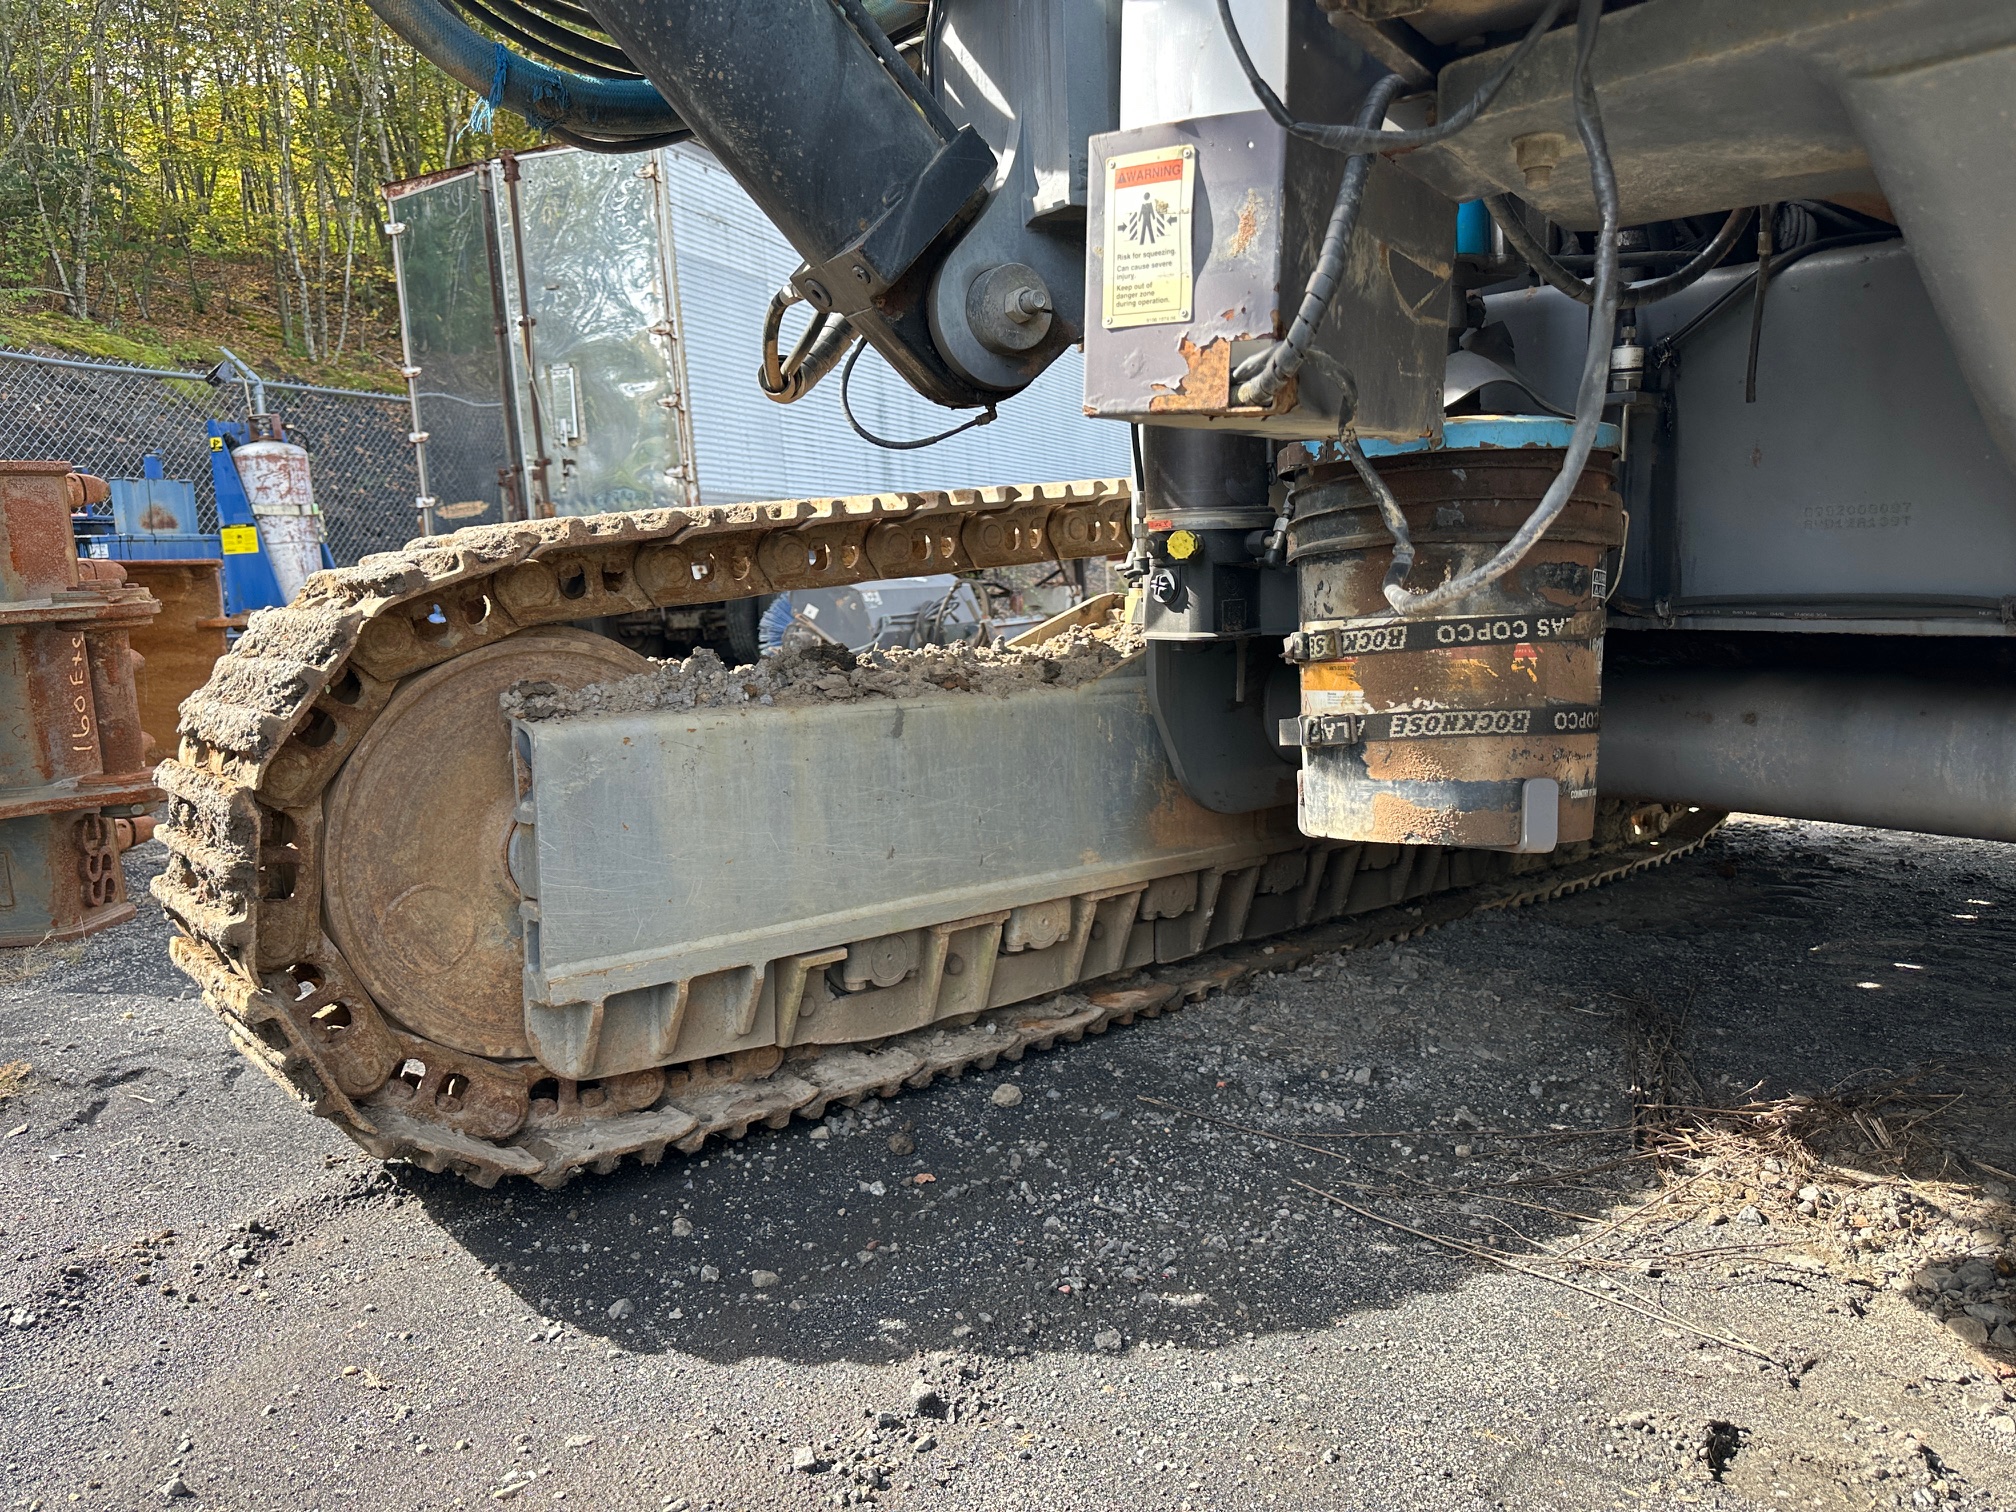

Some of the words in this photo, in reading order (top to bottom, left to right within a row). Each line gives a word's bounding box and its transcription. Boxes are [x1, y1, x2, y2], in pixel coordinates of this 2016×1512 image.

[1126, 163, 1181, 182] WARNING
[1117, 253, 1131, 261] Risk
[1132, 252, 1142, 260] for
[1143, 248, 1177, 259] squeezing.
[1151, 260, 1173, 269] severe
[1146, 281, 1153, 289] of
[1116, 291, 1138, 300] danger
[1139, 290, 1155, 298] zone
[1115, 299, 1137, 308] during
[1137, 297, 1170, 307] operation.
[1437, 619, 1528, 643] COPCO
[72, 694, 93, 752] 160
[1389, 710, 1531, 737] ROCKHOSE
